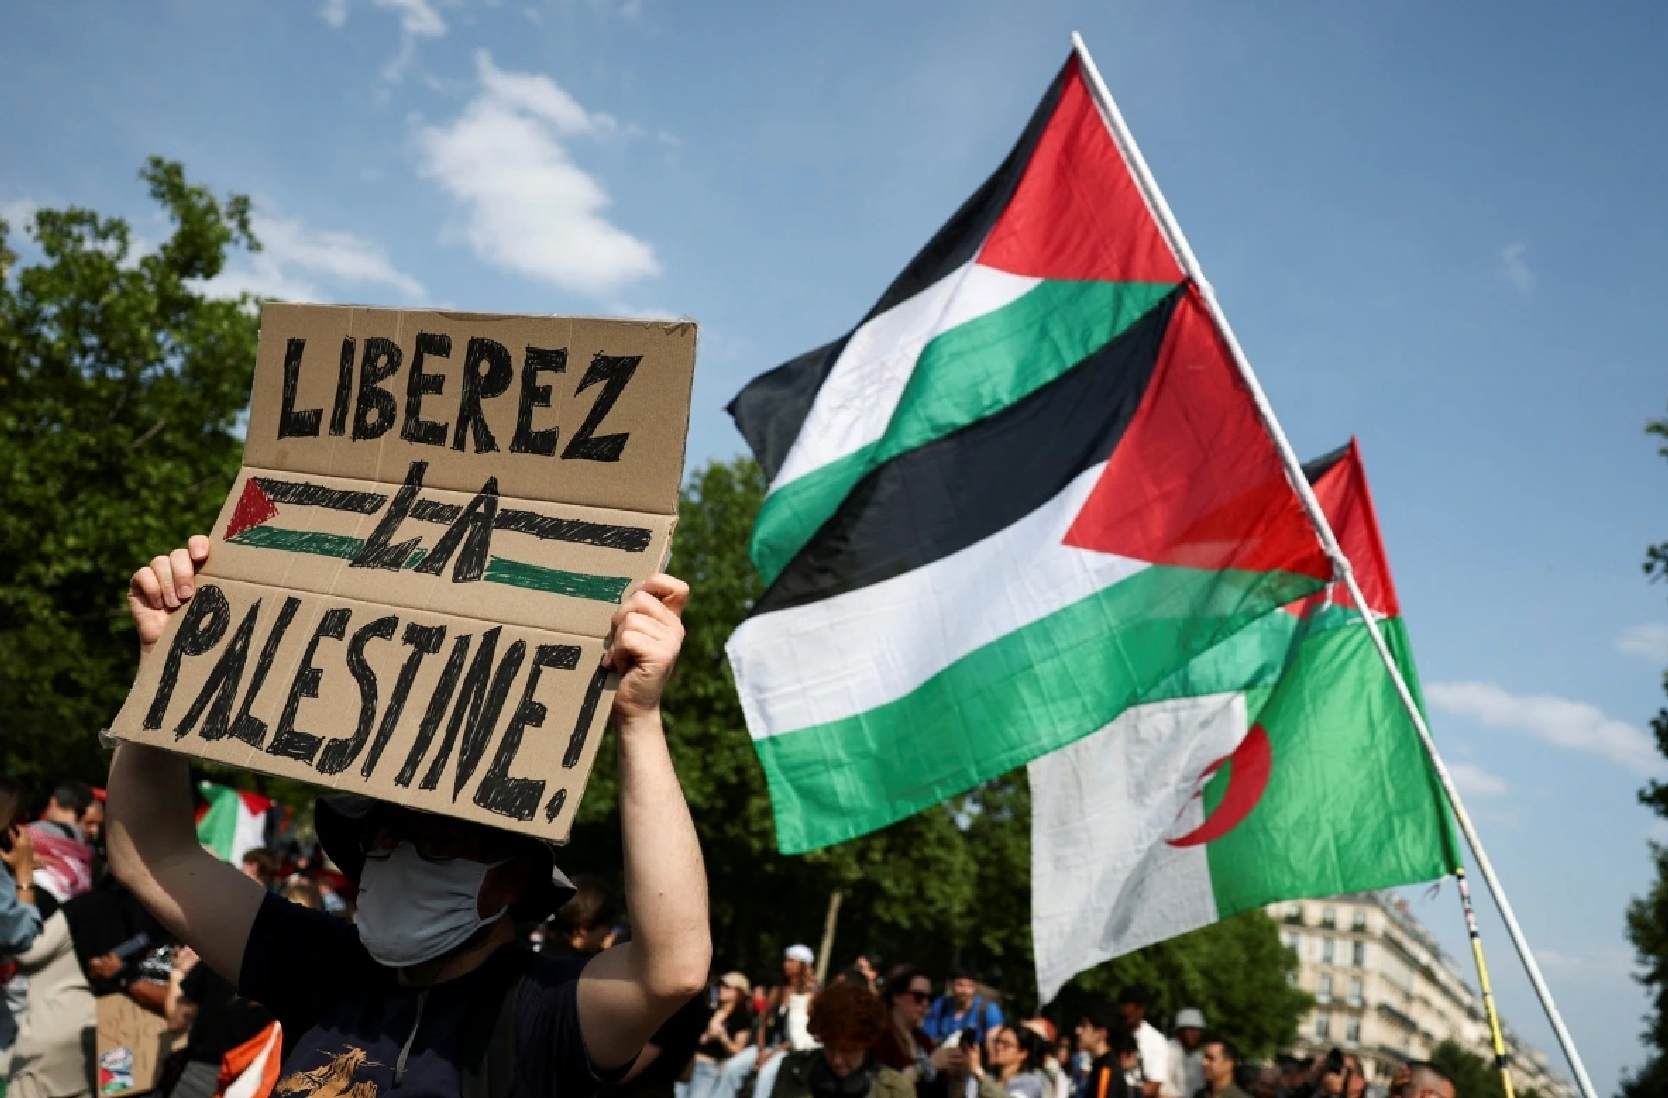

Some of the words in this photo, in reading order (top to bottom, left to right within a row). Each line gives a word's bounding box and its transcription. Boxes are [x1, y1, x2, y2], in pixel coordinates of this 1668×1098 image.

[278, 330, 644, 462] LIBEREZ
[349, 460, 499, 583] LA
[142, 583, 608, 823] PALESTINE!
